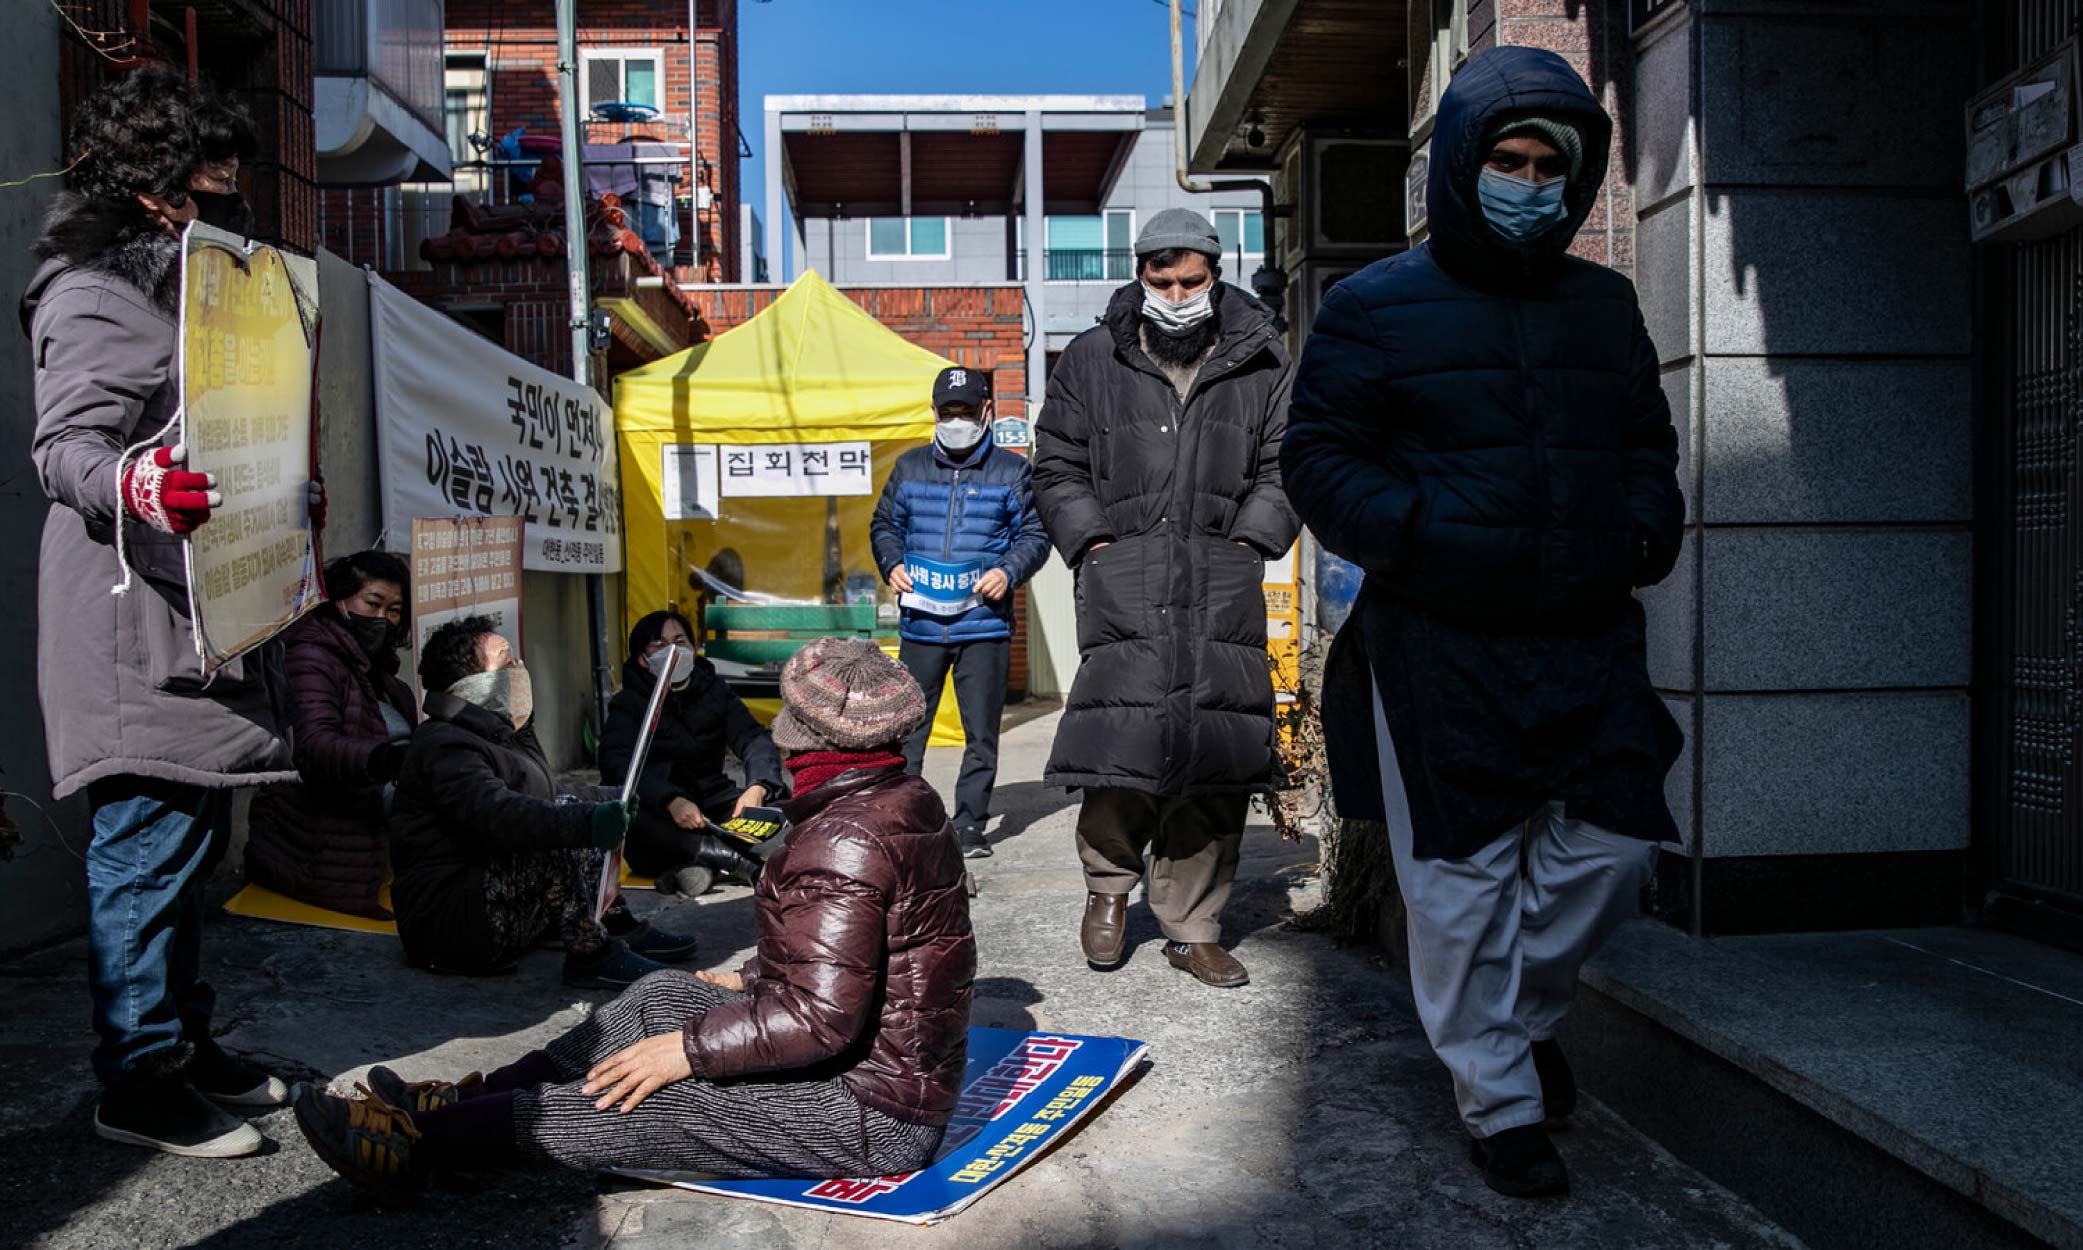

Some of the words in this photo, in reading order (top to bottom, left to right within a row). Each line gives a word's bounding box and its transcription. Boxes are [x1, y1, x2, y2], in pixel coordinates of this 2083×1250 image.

[507, 376, 560, 454] 국민이
[998, 431, 1026, 443] 15-5
[426, 427, 495, 514] 이슬람
[540, 466, 579, 529] 건축
[910, 564, 929, 586] 사원
[931, 571, 955, 592] 공사
[1032, 1075, 1104, 1121] 주민일동
